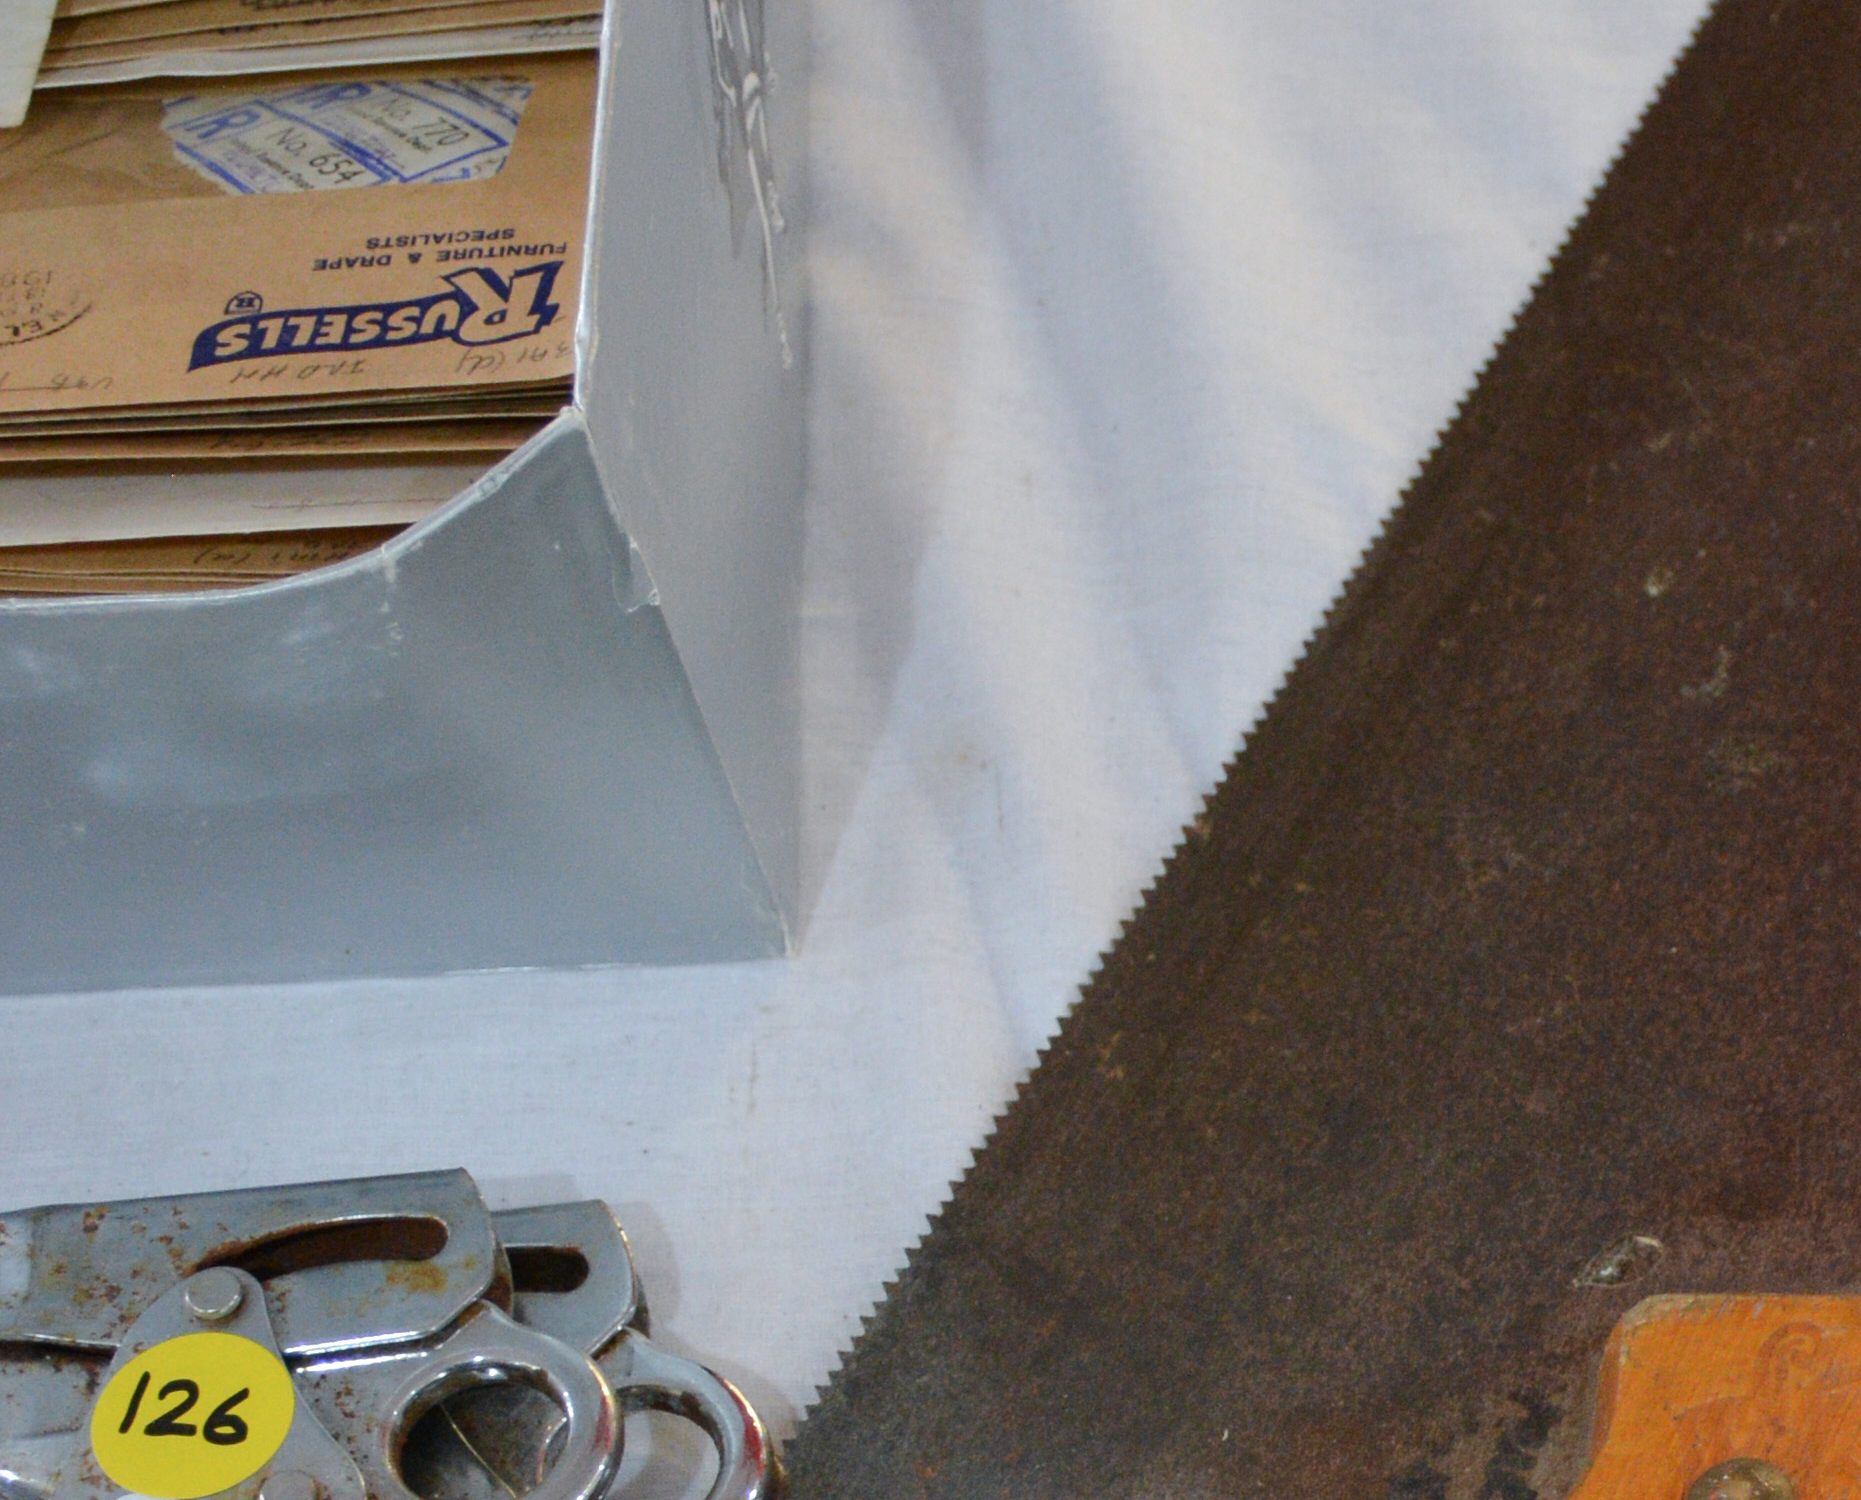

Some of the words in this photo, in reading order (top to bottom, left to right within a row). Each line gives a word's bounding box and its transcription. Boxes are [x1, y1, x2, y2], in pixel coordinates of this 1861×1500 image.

[416, 116, 471, 147] 770
[272, 126, 308, 156] No.
[308, 152, 365, 185] 654
[366, 228, 516, 250] SPECIALISTS
[436, 241, 568, 263] FURNITURE
[312, 254, 392, 271] DRAPE
[407, 252, 422, 264] &
[213, 261, 564, 357] RUSSELLS
[118, 1371, 250, 1446] 126
